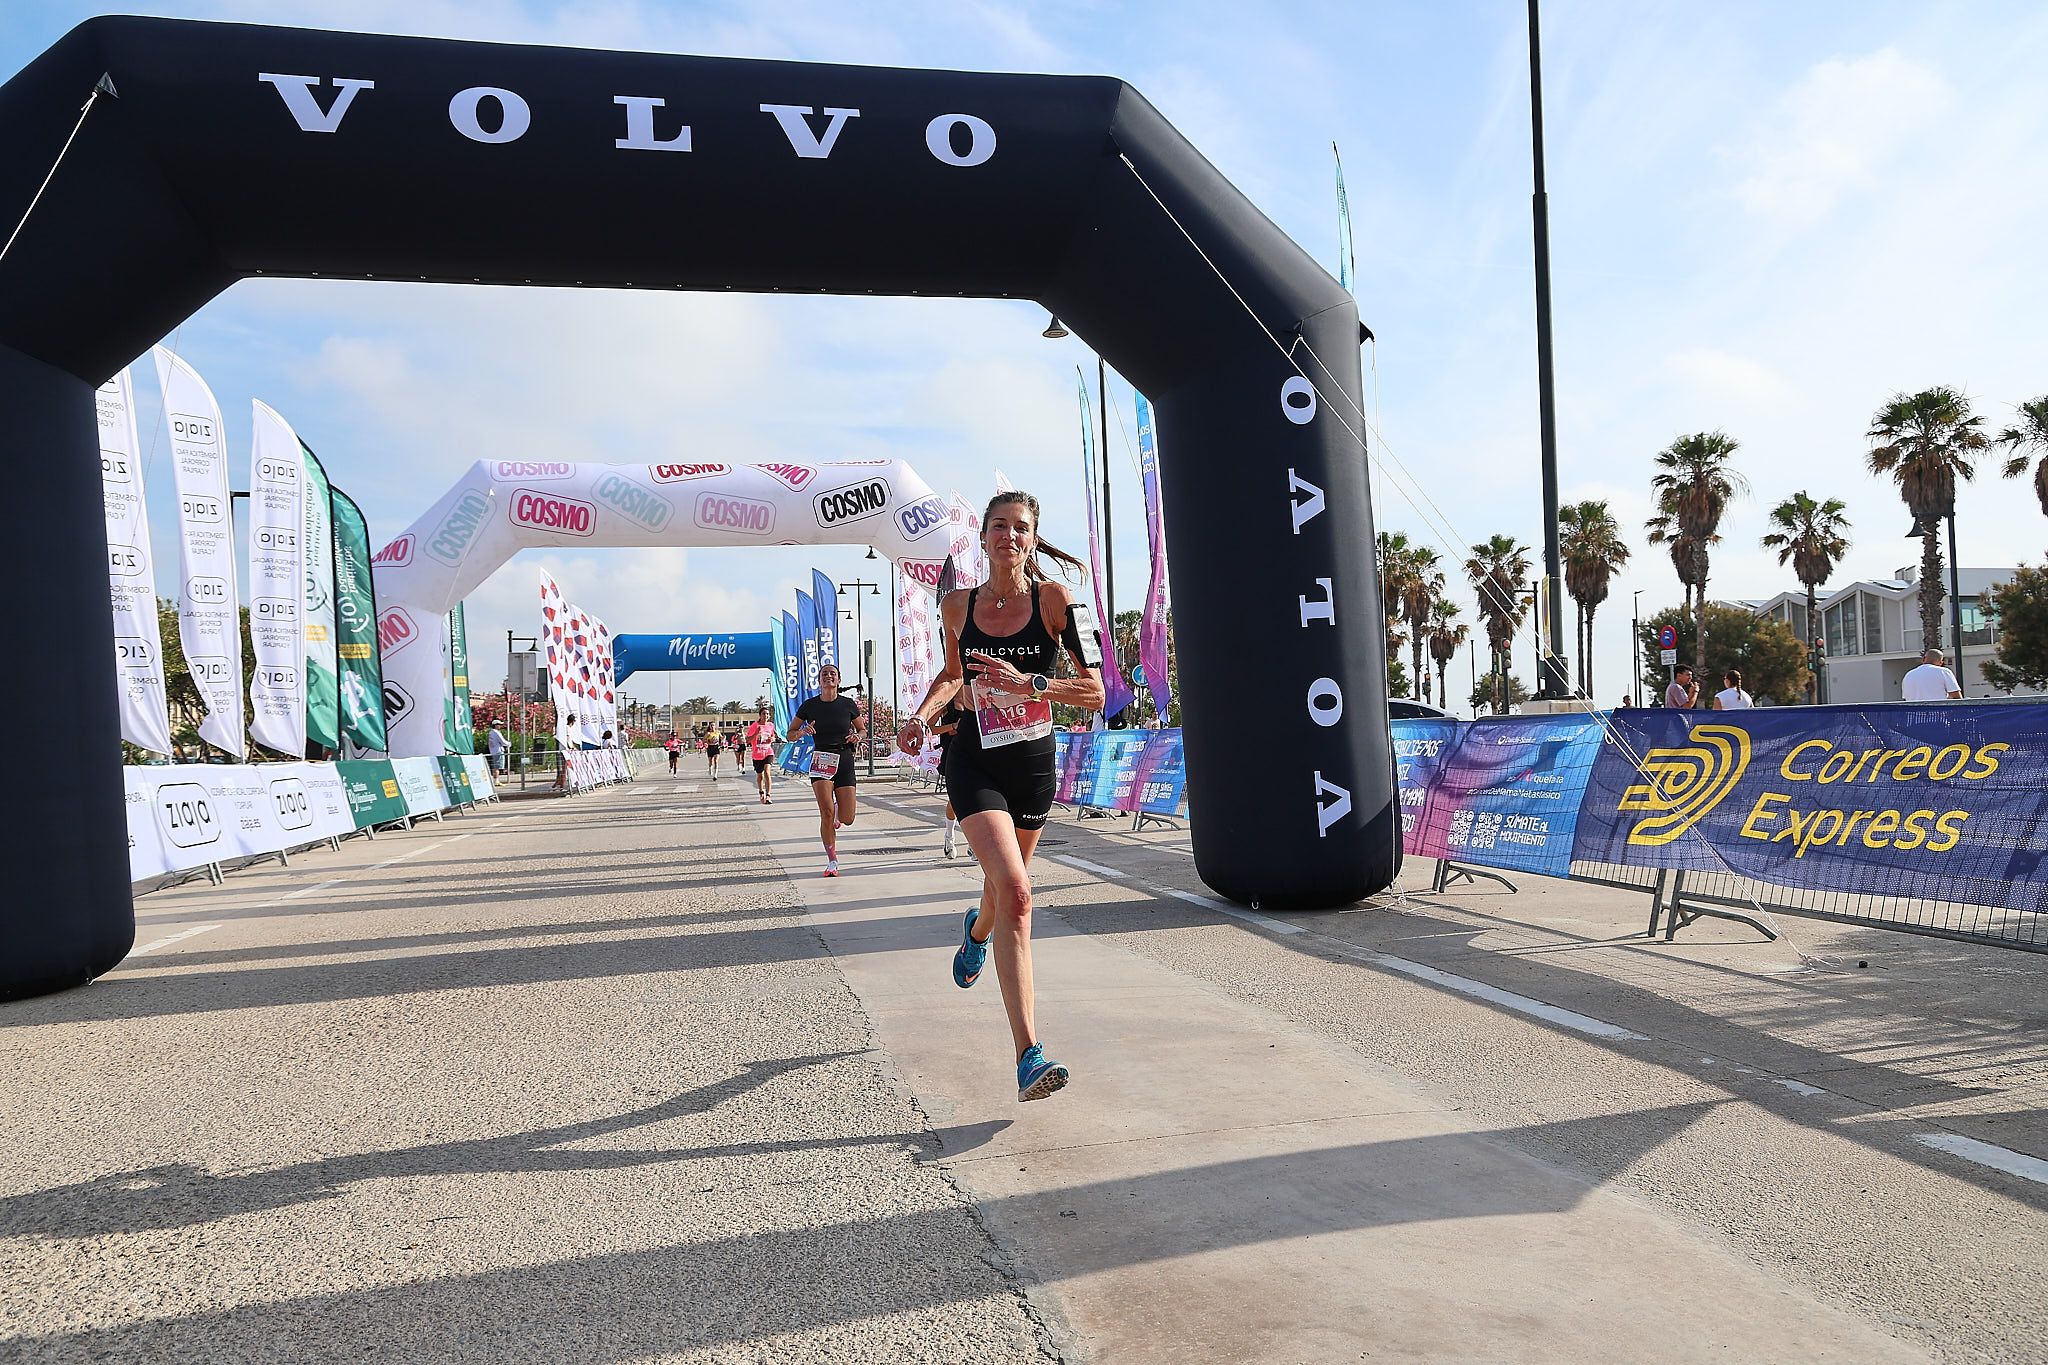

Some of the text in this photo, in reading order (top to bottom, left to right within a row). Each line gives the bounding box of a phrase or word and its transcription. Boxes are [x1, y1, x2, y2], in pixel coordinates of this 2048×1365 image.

[259, 72, 997, 167] VOLVO
[499, 461, 569, 477] COSMO
[656, 464, 724, 479] COSMO
[517, 494, 590, 532] COSMO
[600, 476, 668, 528] COSMO
[701, 497, 769, 531] COSMO
[820, 482, 886, 523] COSMO
[901, 497, 950, 535] COSM
[431, 495, 489, 560] COSMO
[1280, 375, 1352, 838] VOLVO
[965, 645, 1040, 657] SOULCYCLE
[990, 734, 1015, 744] OYSHO
[1780, 739, 2010, 784] Correos
[166, 799, 211, 836] ziaja
[276, 791, 308, 821] ziaja
[1503, 812, 1549, 833] SÚMATE AL
[1500, 830, 1547, 847] MOVIMIENTO
[1740, 792, 1970, 859] Express
